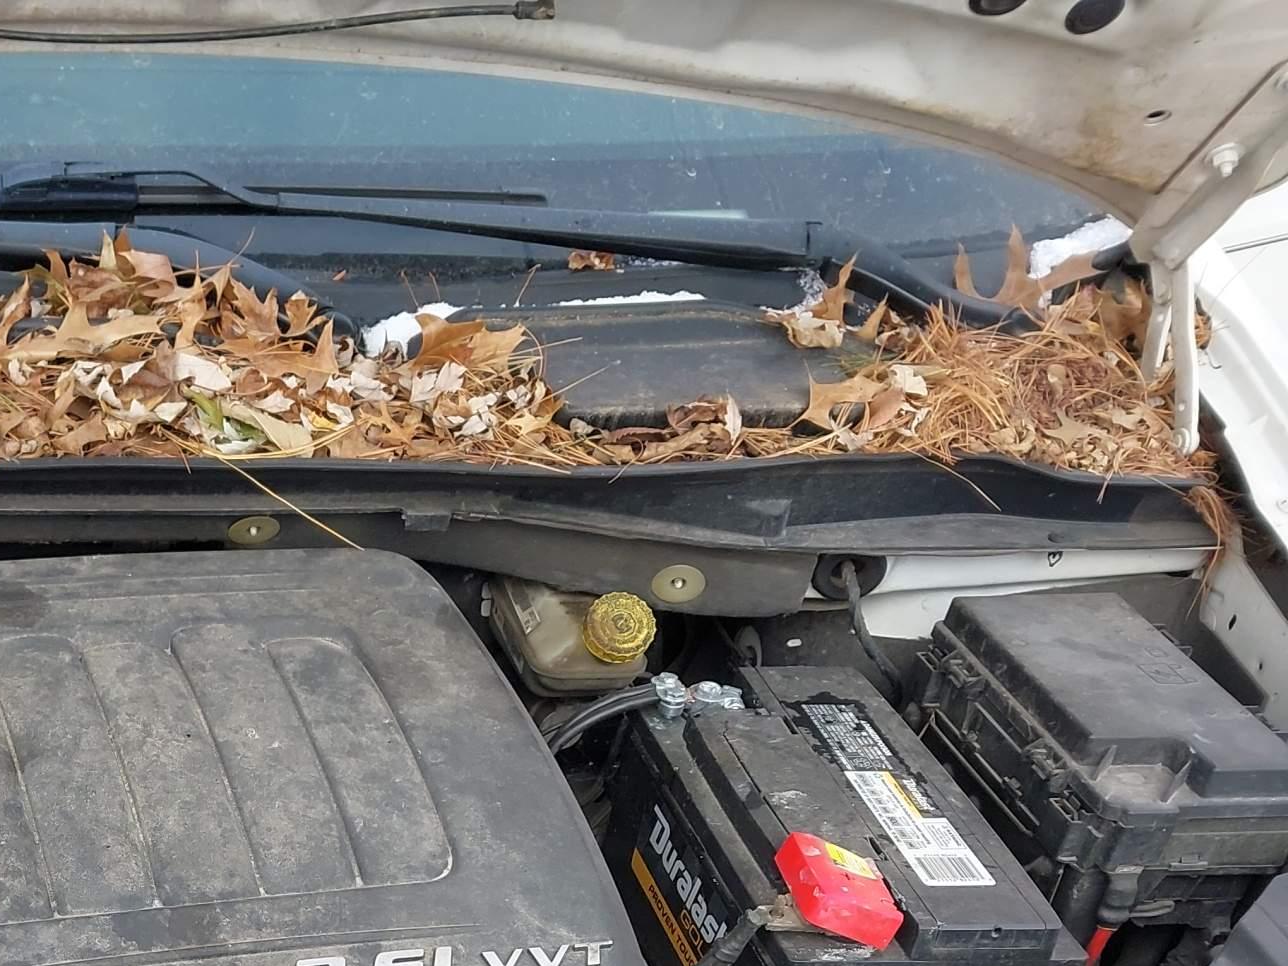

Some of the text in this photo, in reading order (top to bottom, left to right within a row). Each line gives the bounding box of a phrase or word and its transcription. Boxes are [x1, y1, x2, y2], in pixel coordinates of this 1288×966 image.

[649, 804, 727, 944] Duralast
[648, 884, 678, 935] PROVEN
[680, 909, 704, 959] GOL
